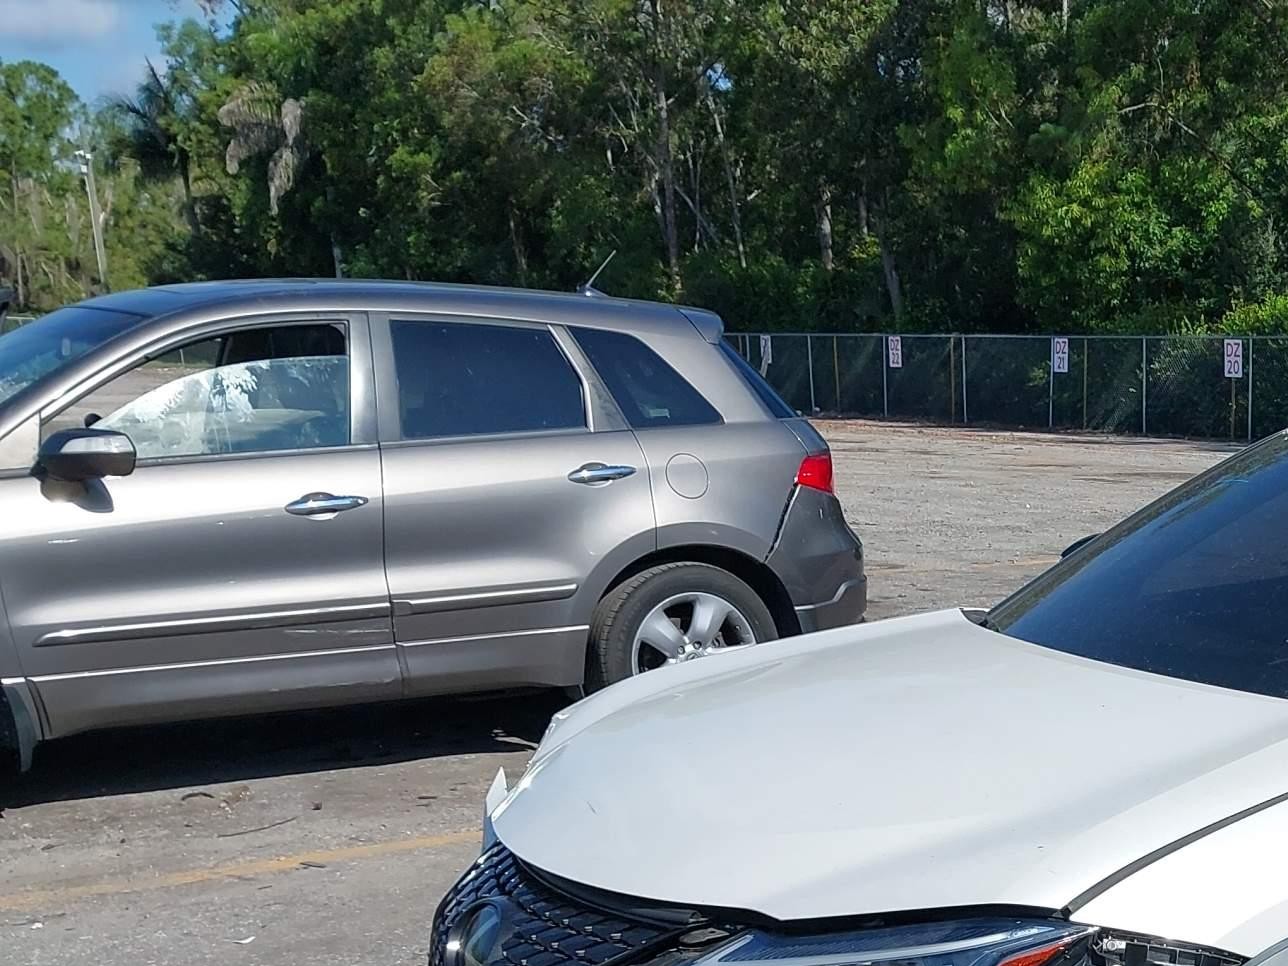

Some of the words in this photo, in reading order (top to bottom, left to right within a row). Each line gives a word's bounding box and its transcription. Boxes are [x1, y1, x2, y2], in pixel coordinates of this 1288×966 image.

[890, 338, 899, 351] DZ
[1055, 341, 1067, 354] DZ
[1226, 343, 1240, 357] DZ
[891, 352, 900, 364] 22
[1057, 356, 1066, 369] 21
[1227, 360, 1240, 374] 20
